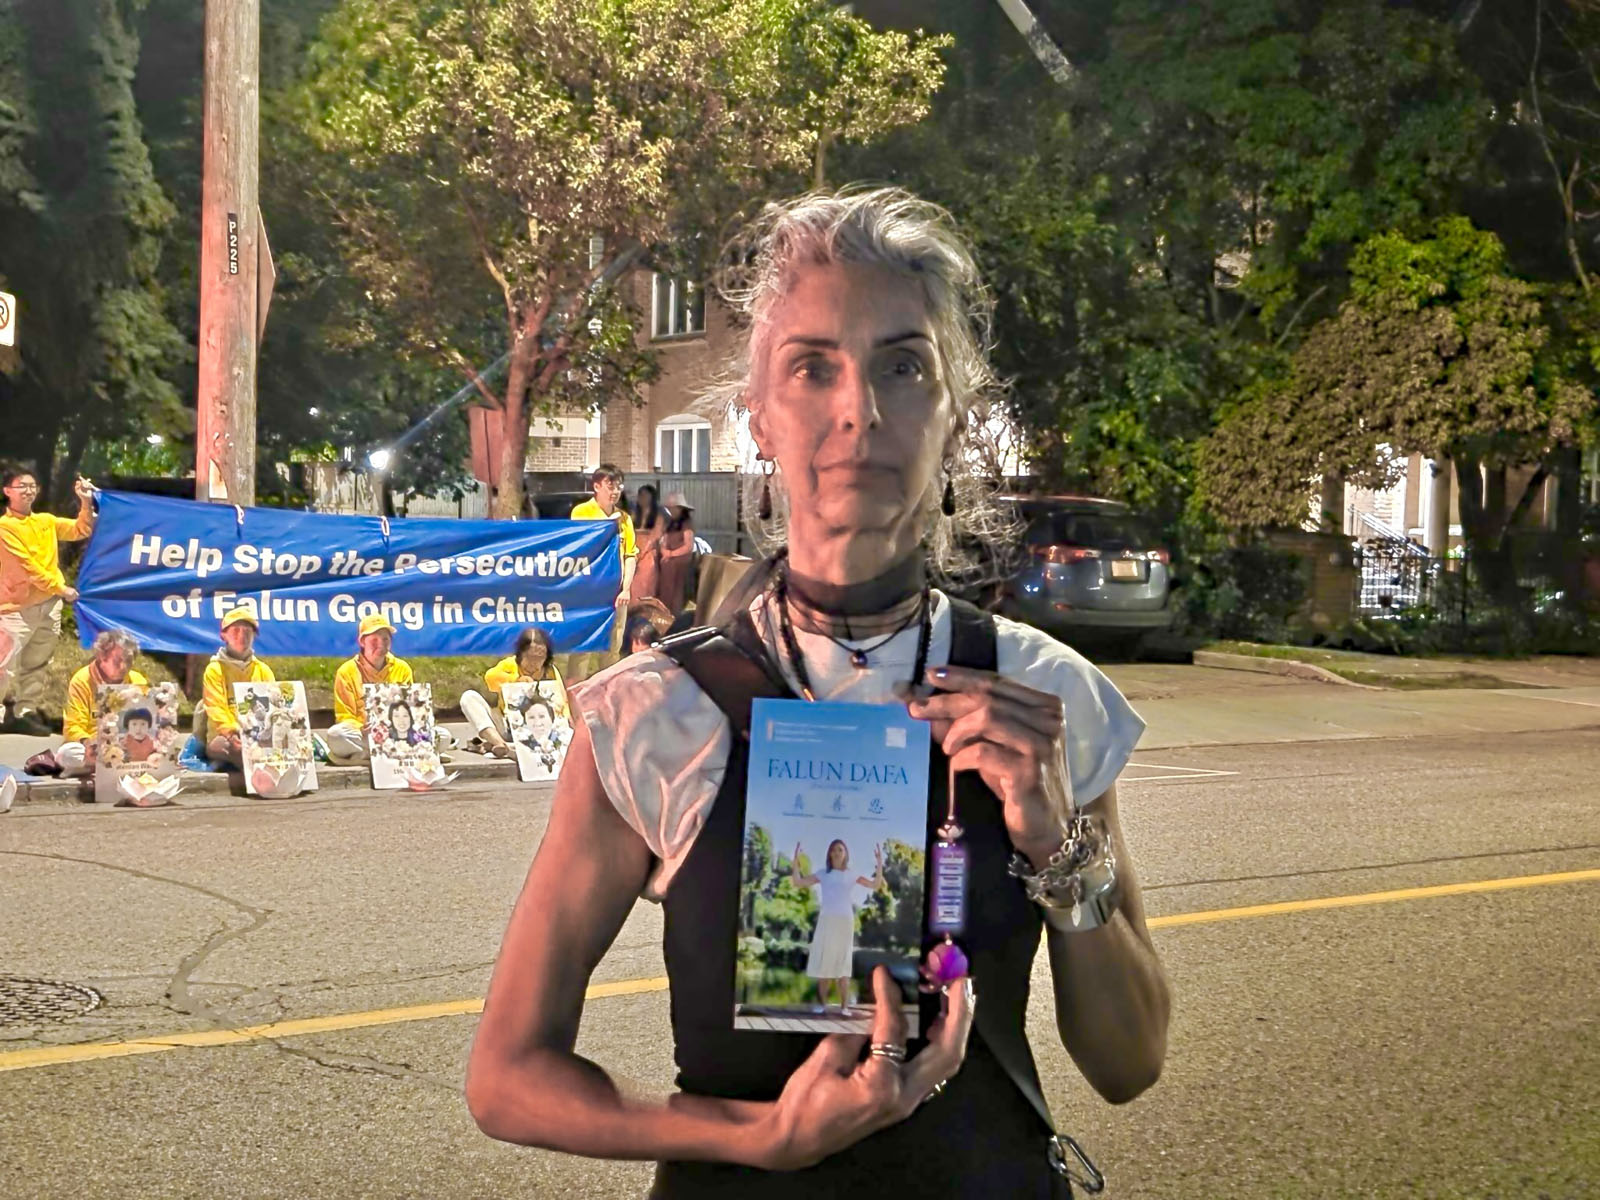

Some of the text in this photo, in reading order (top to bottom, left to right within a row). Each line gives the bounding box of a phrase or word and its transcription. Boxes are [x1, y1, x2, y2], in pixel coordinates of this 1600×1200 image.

[229, 221, 238, 274] P225
[130, 533, 592, 579] Help Stop the Persecution
[161, 588, 203, 619] of
[328, 594, 424, 631] Gong
[432, 595, 464, 624] in
[472, 596, 565, 624] China
[768, 758, 909, 785] FALUN DAFA
